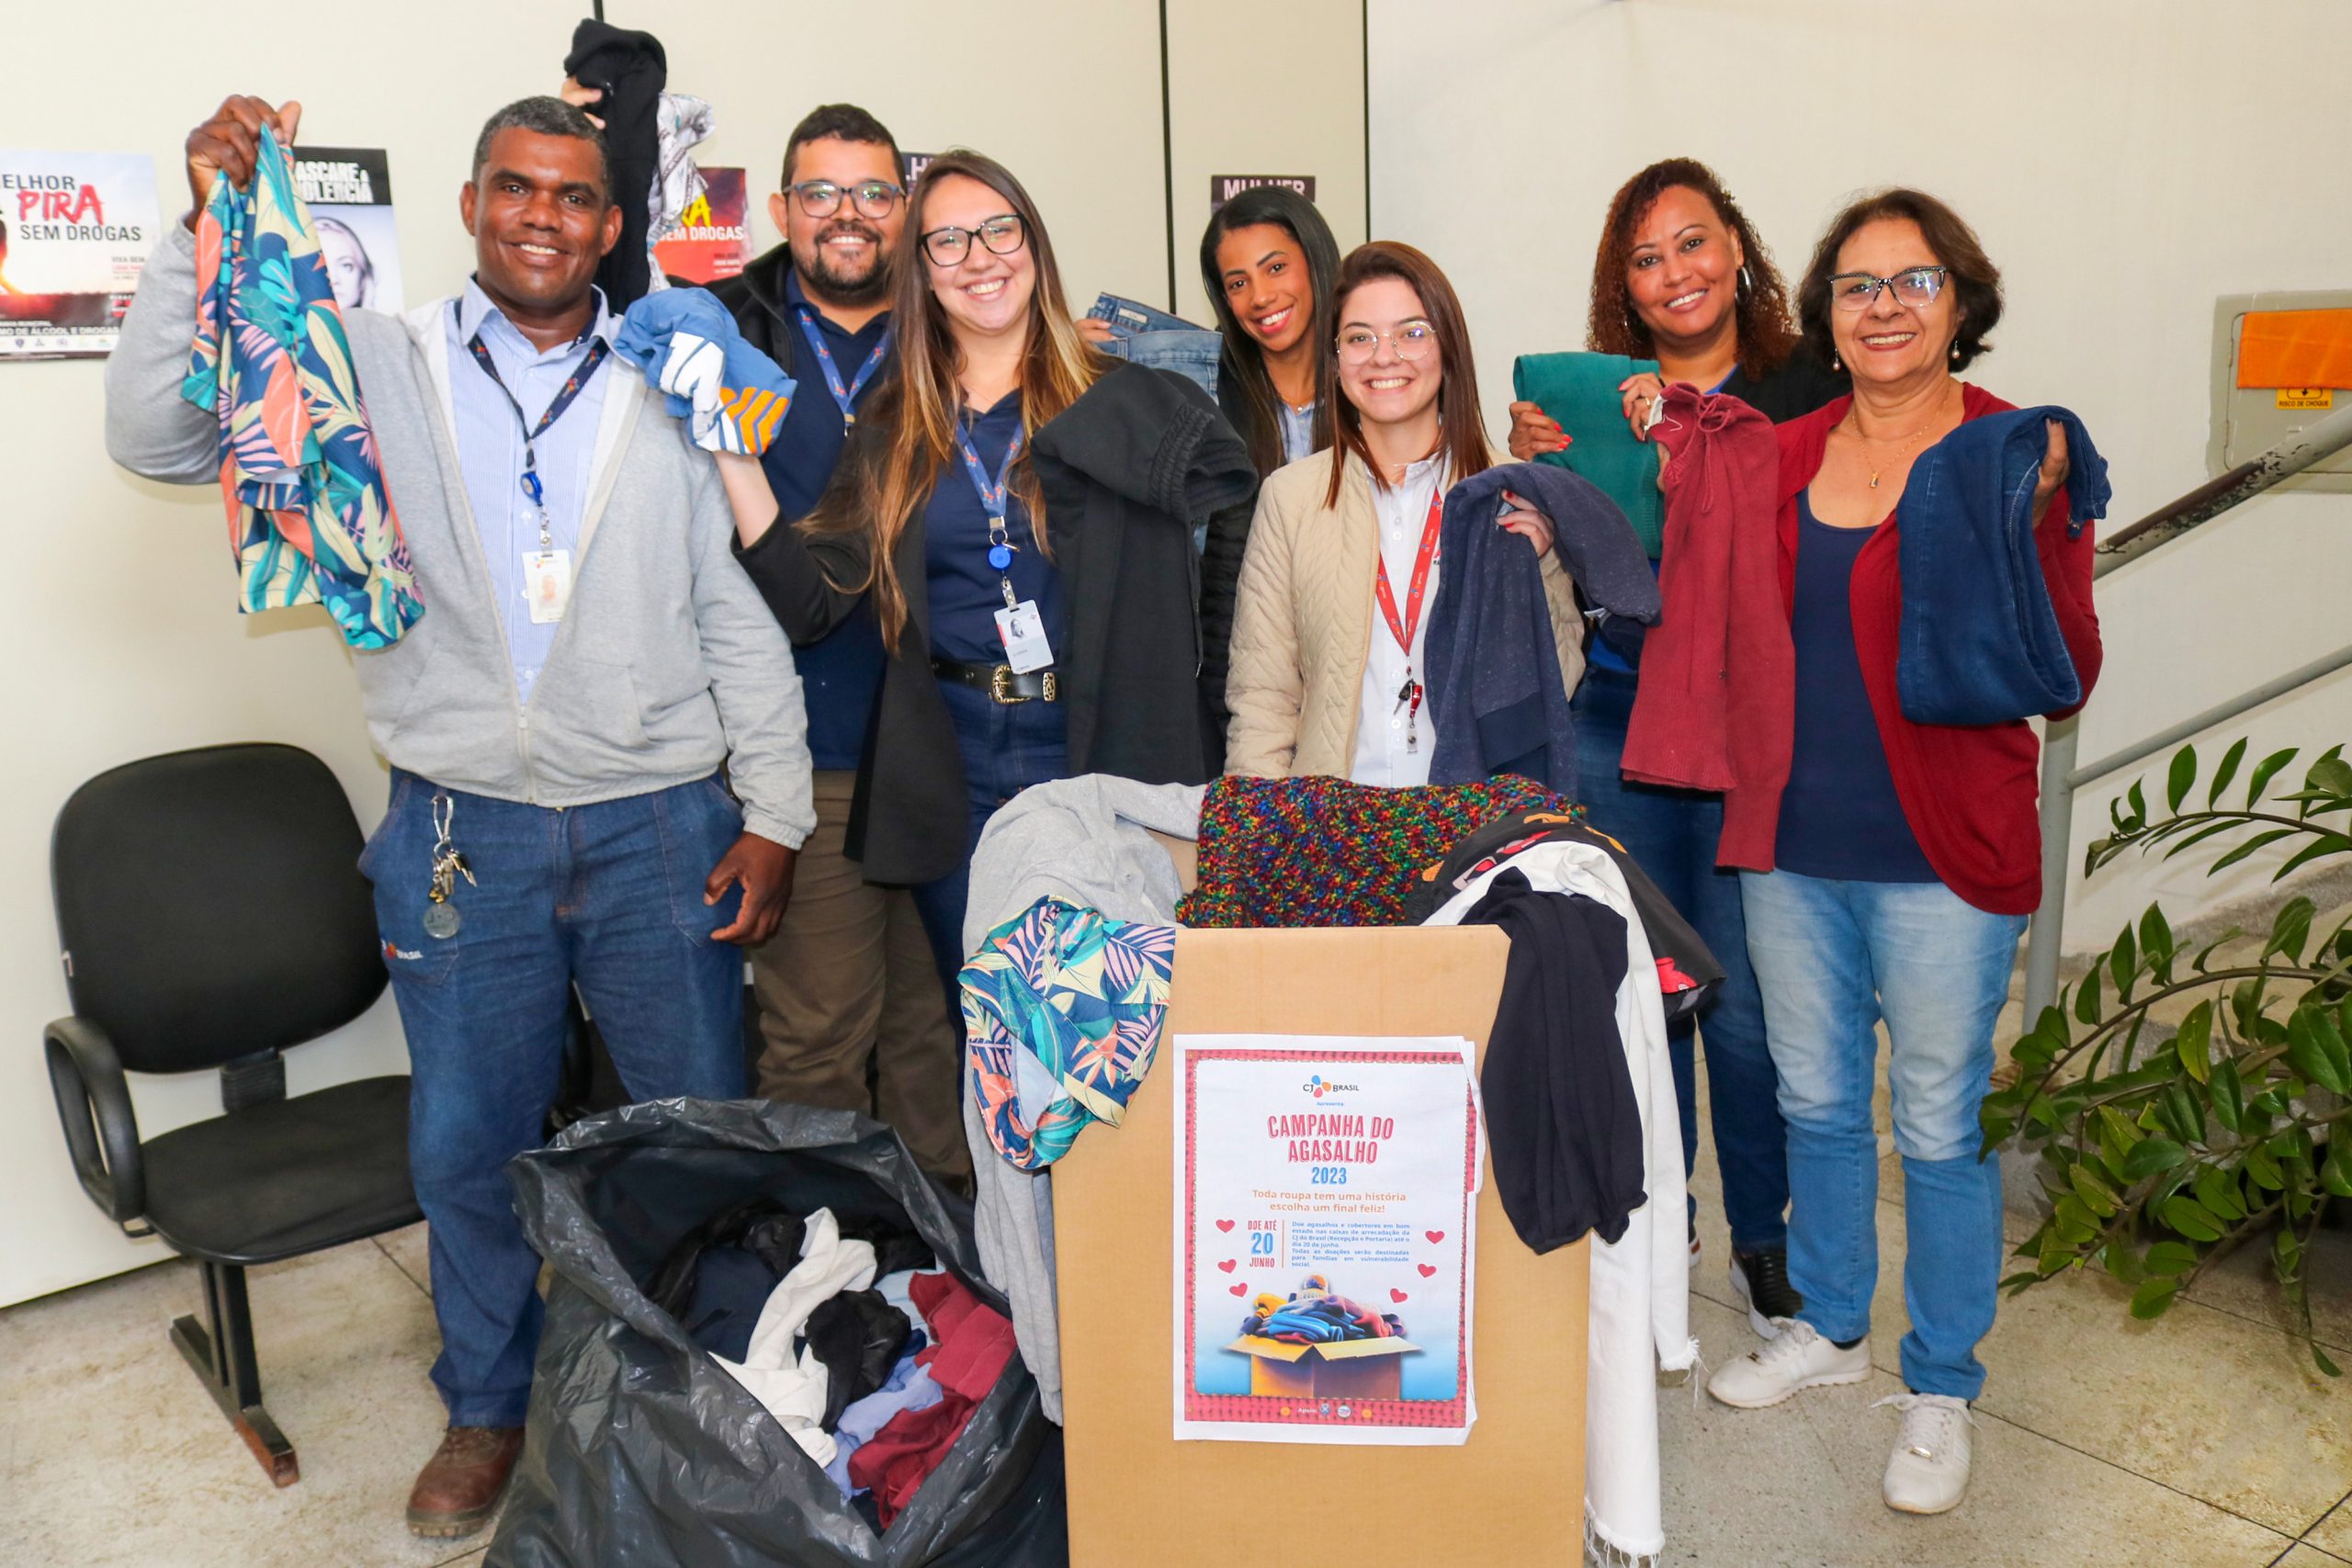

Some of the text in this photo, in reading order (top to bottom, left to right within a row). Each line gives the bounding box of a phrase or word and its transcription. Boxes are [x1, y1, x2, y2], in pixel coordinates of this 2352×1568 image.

[295, 161, 360, 182] ASCARE
[0, 175, 75, 190] ELHOR
[17, 184, 104, 226] PIRA
[20, 225, 141, 242] SEM DROGAS
[690, 226, 744, 241] DROGAS
[1303, 1084, 1360, 1093] CJ BRASIL
[1267, 1113, 1395, 1140] CAMPANHA DO
[1288, 1139, 1379, 1164] AGASALHO
[1311, 1167, 1348, 1185] 2023
[1252, 1190, 1407, 1202] Toda roupa tem uma história
[1270, 1202, 1310, 1213] escolha
[1333, 1203, 1357, 1213] final
[1360, 1203, 1385, 1213] feliz!
[1248, 1219, 1277, 1231] DOE ATÉ
[1250, 1232, 1273, 1255] 20
[1250, 1257, 1275, 1269] JUNHO
